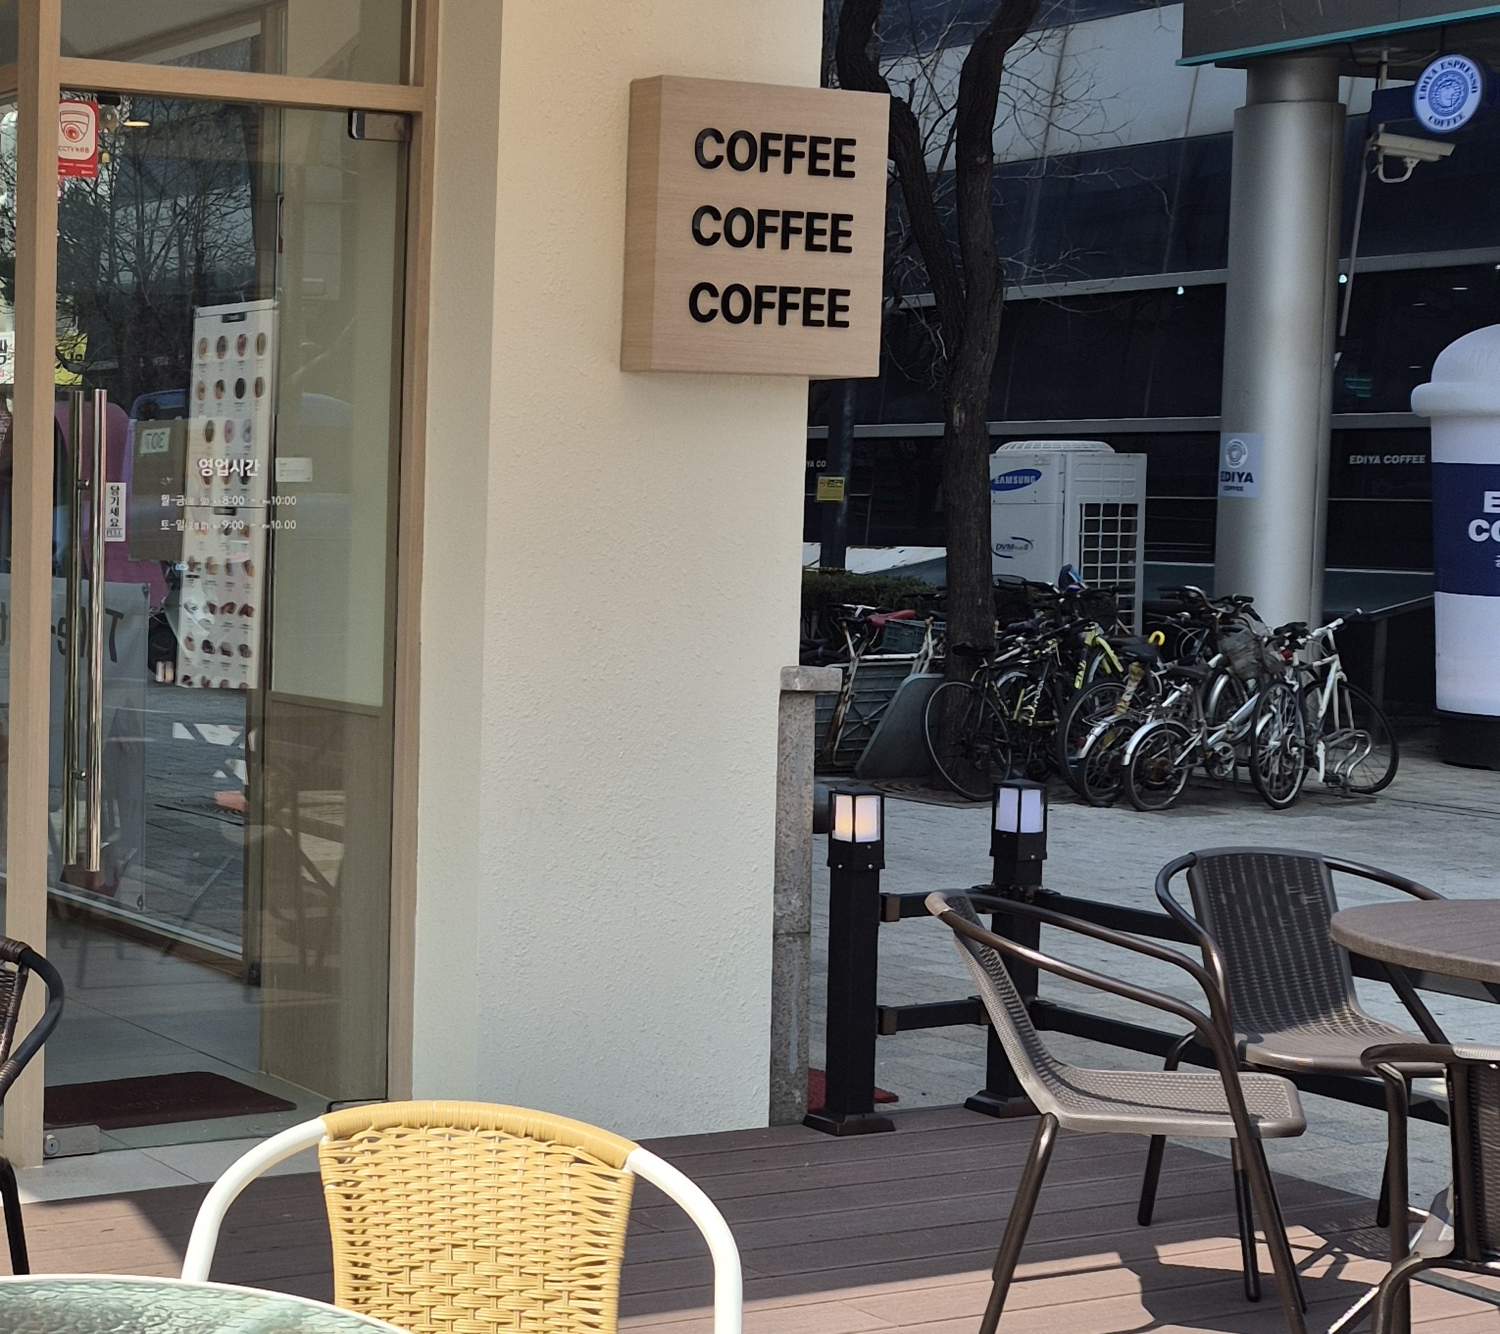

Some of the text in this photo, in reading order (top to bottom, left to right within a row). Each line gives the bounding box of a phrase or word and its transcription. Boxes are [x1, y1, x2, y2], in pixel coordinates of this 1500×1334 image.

[694, 127, 857, 179] COFFEE
[691, 205, 854, 254] COFFEE
[688, 281, 851, 329] COFFEE
[198, 457, 261, 478] 영업시간
[1349, 454, 1426, 465] EDIYA COFFEE
[993, 475, 1036, 485] SAMSUNG
[1220, 471, 1254, 484] EDIYA
[109, 485, 120, 527] 당기세요
